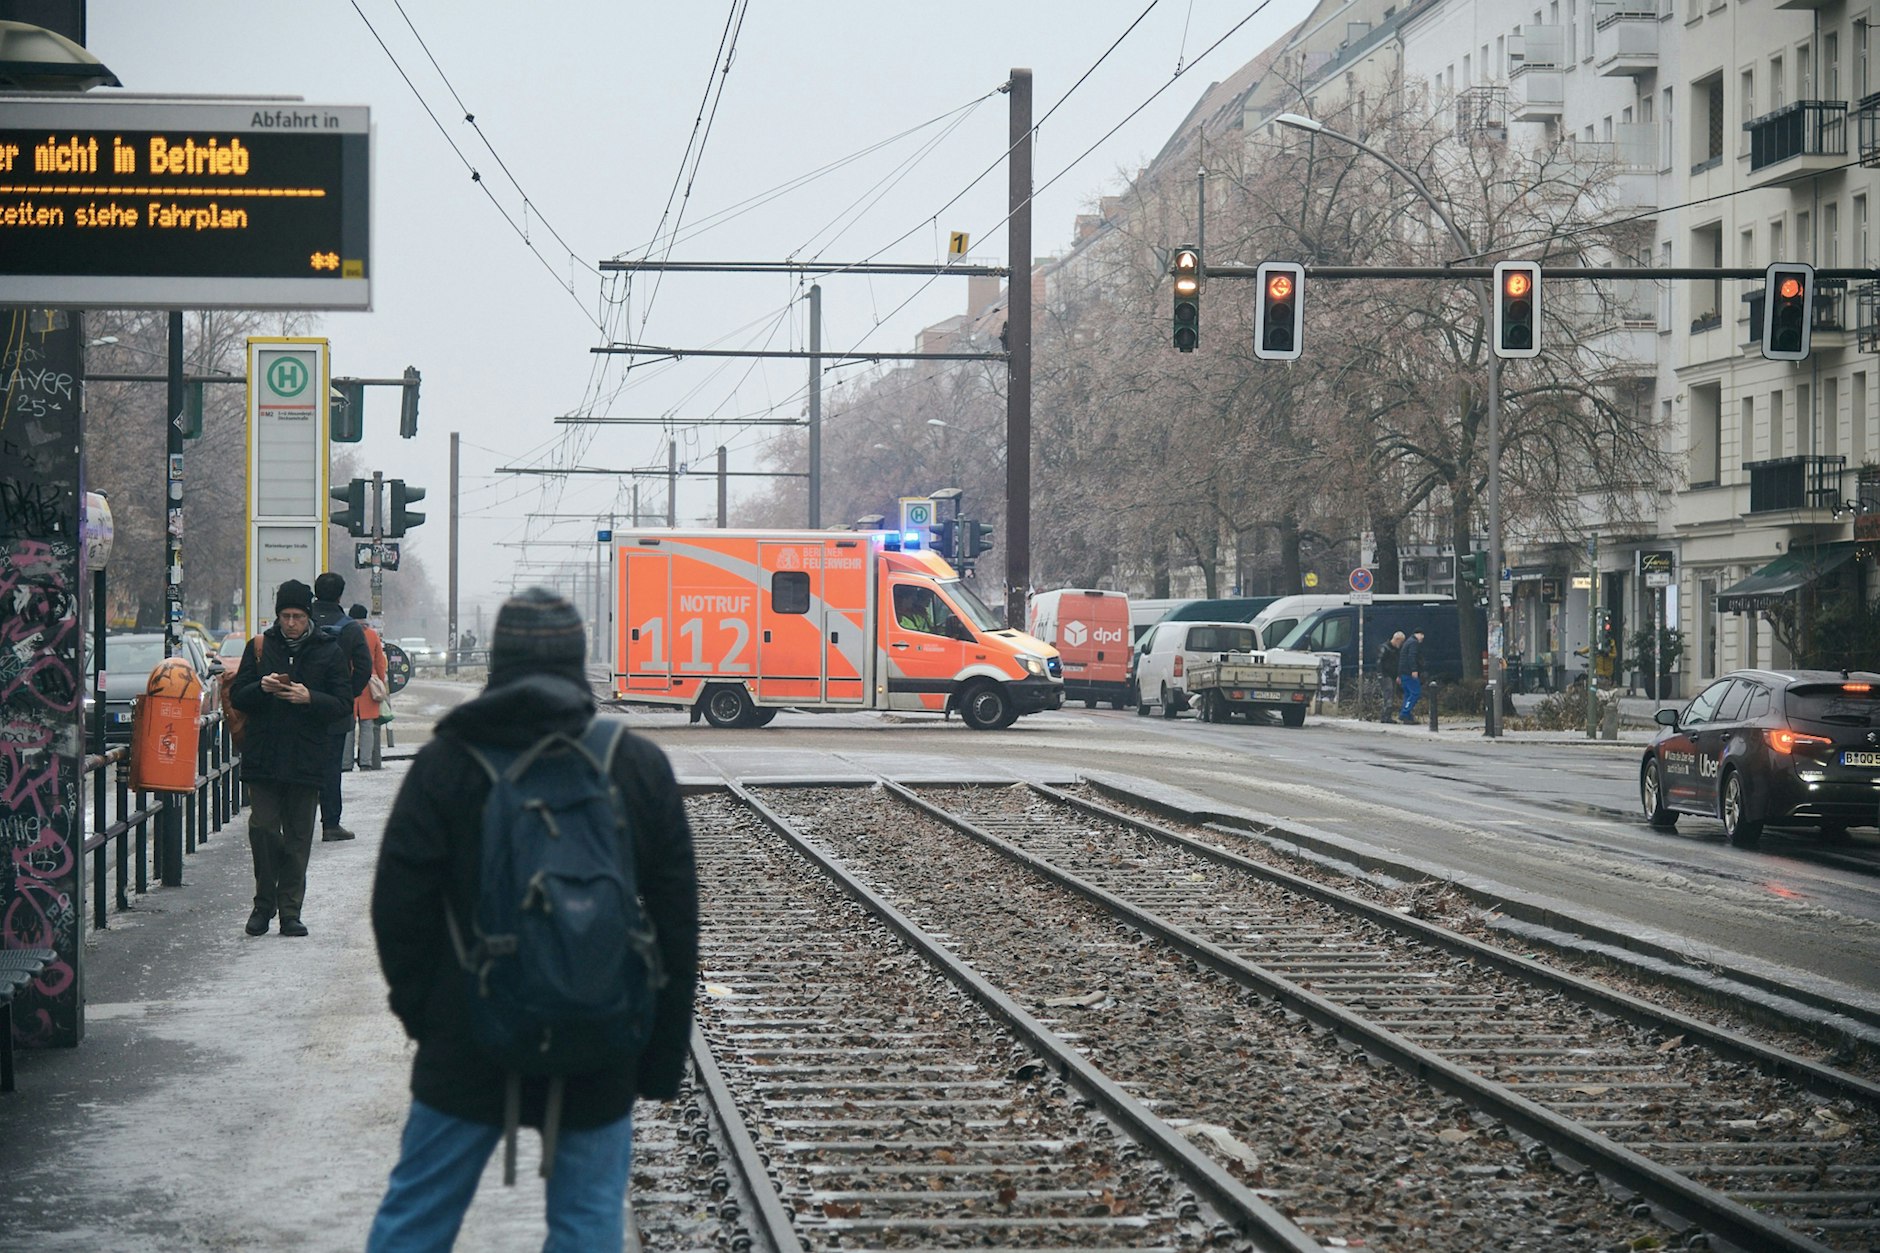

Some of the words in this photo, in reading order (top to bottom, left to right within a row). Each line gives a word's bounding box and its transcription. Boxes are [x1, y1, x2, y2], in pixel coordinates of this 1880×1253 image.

[251, 111, 318, 129] Abfahrt
[324, 112, 339, 128] in
[35, 136, 98, 173] nicht
[114, 136, 136, 174] in
[150, 137, 249, 175] Betrieb
[75, 202, 138, 227] siehe
[148, 203, 248, 231] Fahrplan
[953, 233, 963, 253] 1
[803, 548, 843, 557] BERLINER
[803, 557, 862, 569] FEUERWEHR
[680, 595, 750, 613] NOTRUF
[640, 616, 751, 673] 112
[1093, 627, 1121, 644] dpd
[1700, 753, 1719, 778] Uber
[1846, 753, 1853, 763] B
[1860, 754, 1874, 764] QQ
